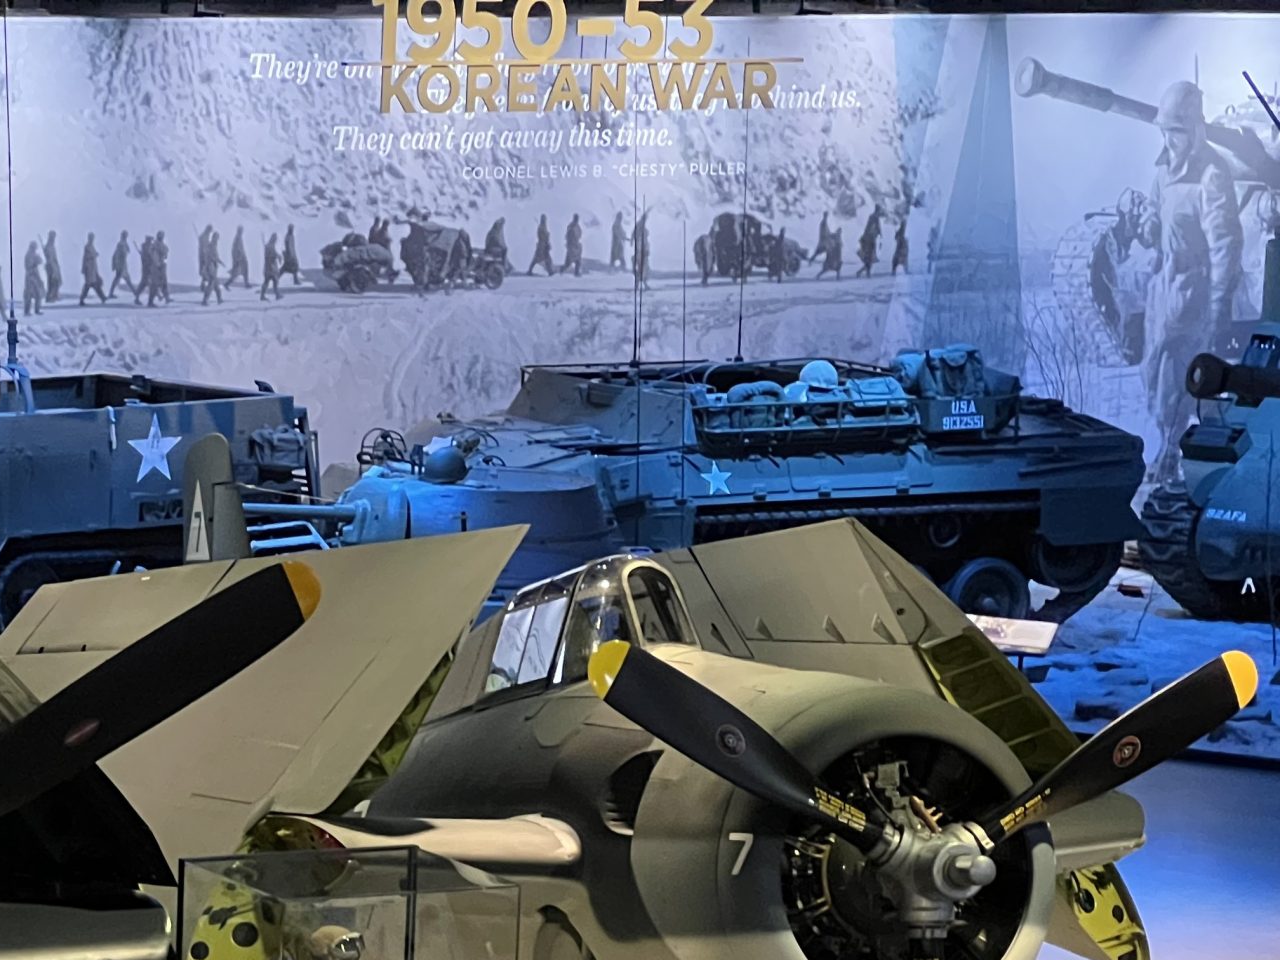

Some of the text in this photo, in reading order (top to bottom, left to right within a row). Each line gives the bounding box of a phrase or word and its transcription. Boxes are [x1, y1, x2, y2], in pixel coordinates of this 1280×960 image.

[248, 53, 338, 85] They're
[380, 63, 628, 113] KOREAN
[647, 61, 778, 111] WAR
[831, 89, 862, 108] us.
[332, 122, 674, 155] They can't get away this time.
[462, 165, 535, 180] COLONEL
[540, 165, 588, 179] LEWIS
[592, 164, 606, 178] B.
[689, 162, 747, 177] PULLER
[951, 399, 977, 415] USA
[193, 511, 202, 553] 7
[728, 832, 754, 876] 7
